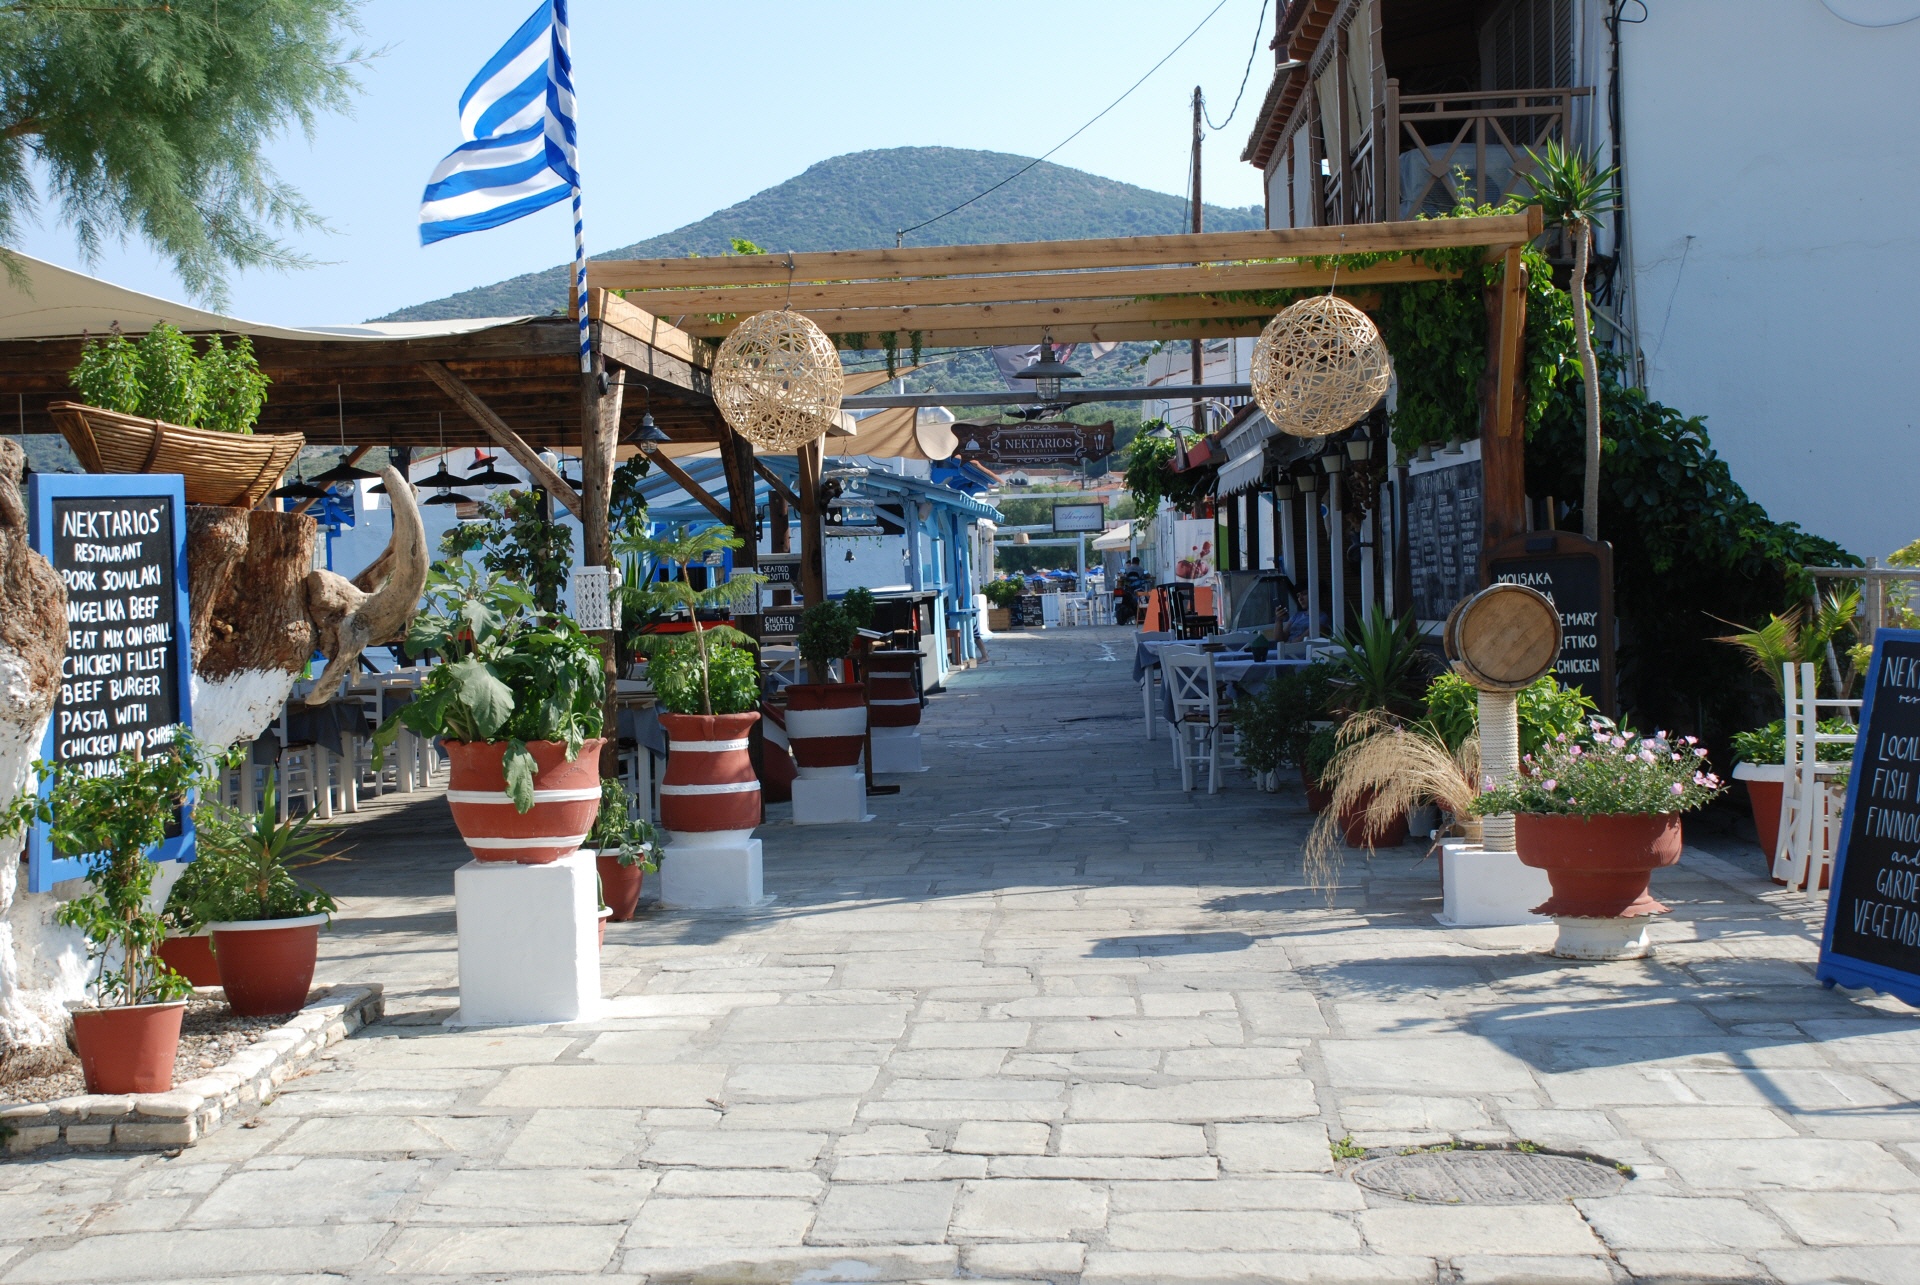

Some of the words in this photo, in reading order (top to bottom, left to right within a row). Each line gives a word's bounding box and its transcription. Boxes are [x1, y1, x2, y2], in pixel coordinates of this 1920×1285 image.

[1005, 437, 1072, 450] NEKTARIOS
[74, 541, 143, 563] RESTAURANT
[61, 568, 97, 592] PORK
[101, 563, 161, 592] SOUVLAKI
[763, 565, 790, 573] SEAFOOD
[1497, 572, 1553, 586] MOUSAKA
[129, 595, 159, 620] BEEF
[764, 615, 795, 624] CHICKEN
[1559, 612, 1598, 627] EMARY
[103, 628, 125, 649] MIX
[126, 626, 143, 647] ON
[143, 621, 173, 643] GRILL
[764, 623, 794, 632] RISOTTO
[61, 652, 121, 679] CHICKEN
[126, 646, 168, 672] FILLET
[1556, 657, 1600, 674] CHICKEN
[1882, 656, 1920, 690] NEK
[61, 679, 104, 706] BEEF
[109, 674, 161, 701] BURGER
[60, 708, 109, 735] PASTA
[115, 703, 148, 725] WITH
[60, 733, 118, 760] CHICKEN
[120, 730, 145, 752] AND
[1878, 731, 1920, 762] LOCAL
[1871, 767, 1910, 801] FISH
[1891, 850, 1920, 867] and
[1876, 867, 1920, 903] GARDE
[1853, 898, 1920, 948] VEGETAB
